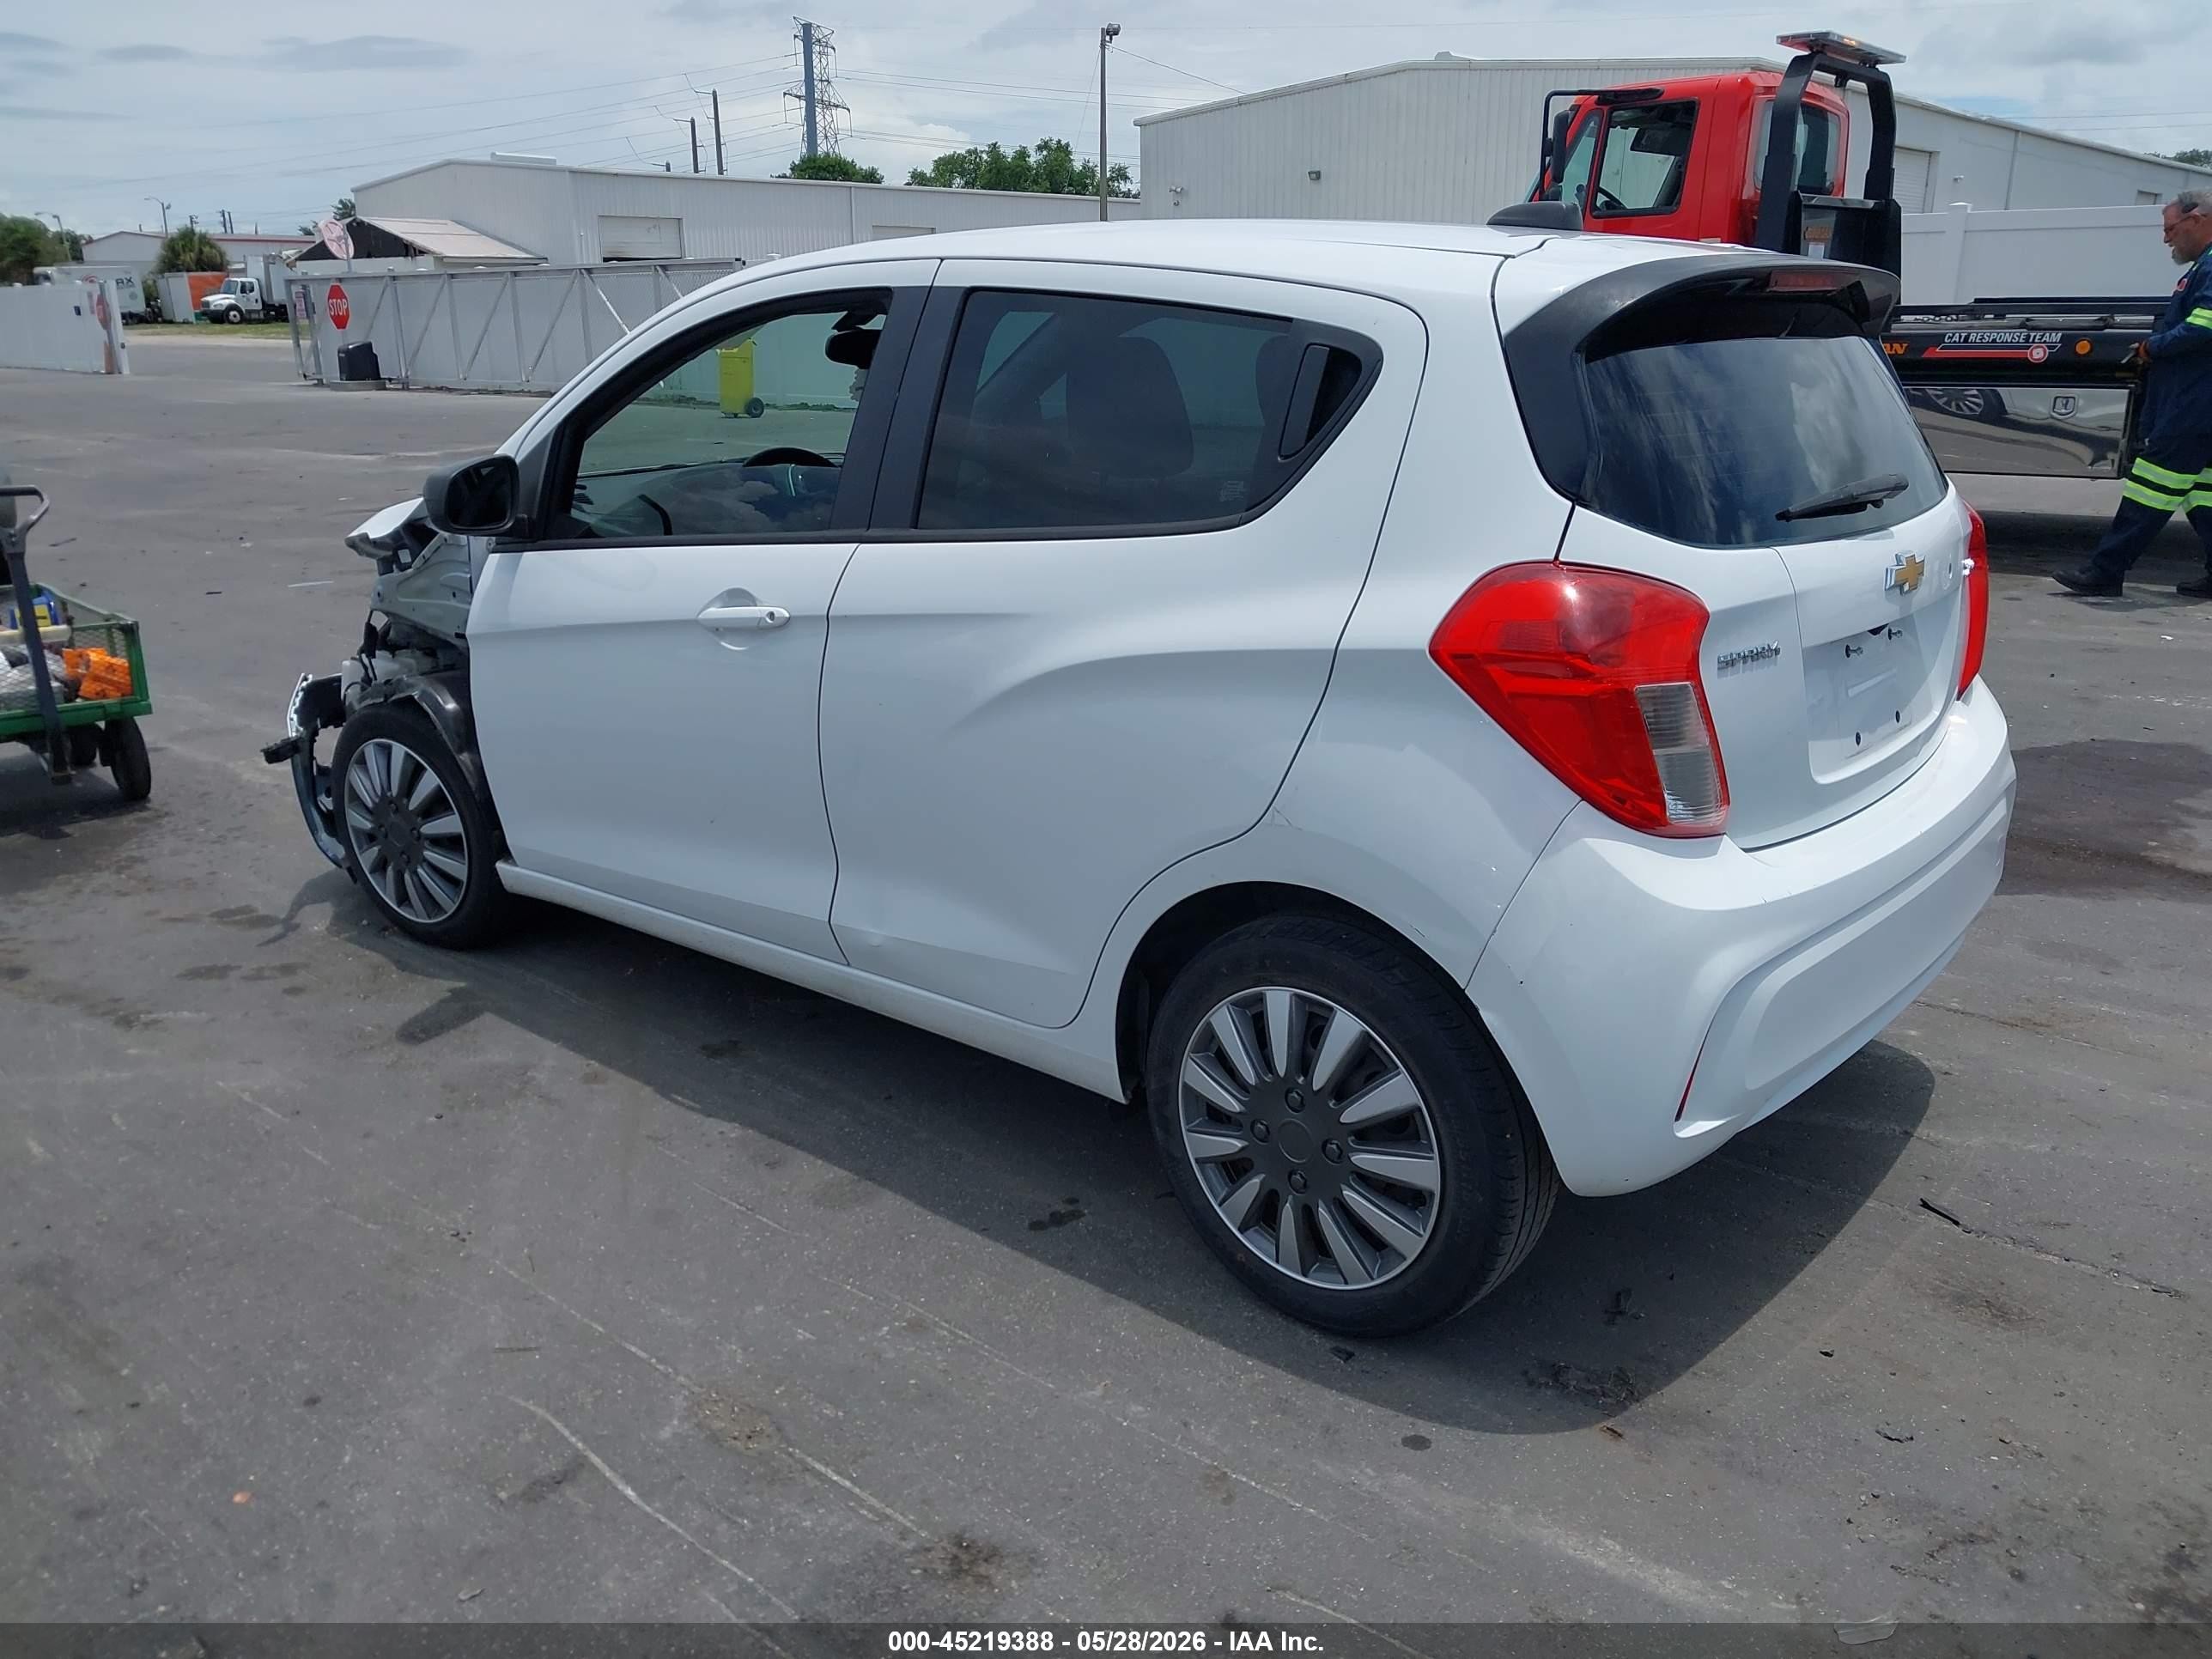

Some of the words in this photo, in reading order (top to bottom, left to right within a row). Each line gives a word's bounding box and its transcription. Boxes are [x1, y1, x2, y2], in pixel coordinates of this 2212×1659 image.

[329, 298, 348, 316] STOP
[1944, 332, 1967, 343] CAT
[1968, 332, 2027, 343] RESPONSE
[2028, 332, 2062, 343] TEAM
